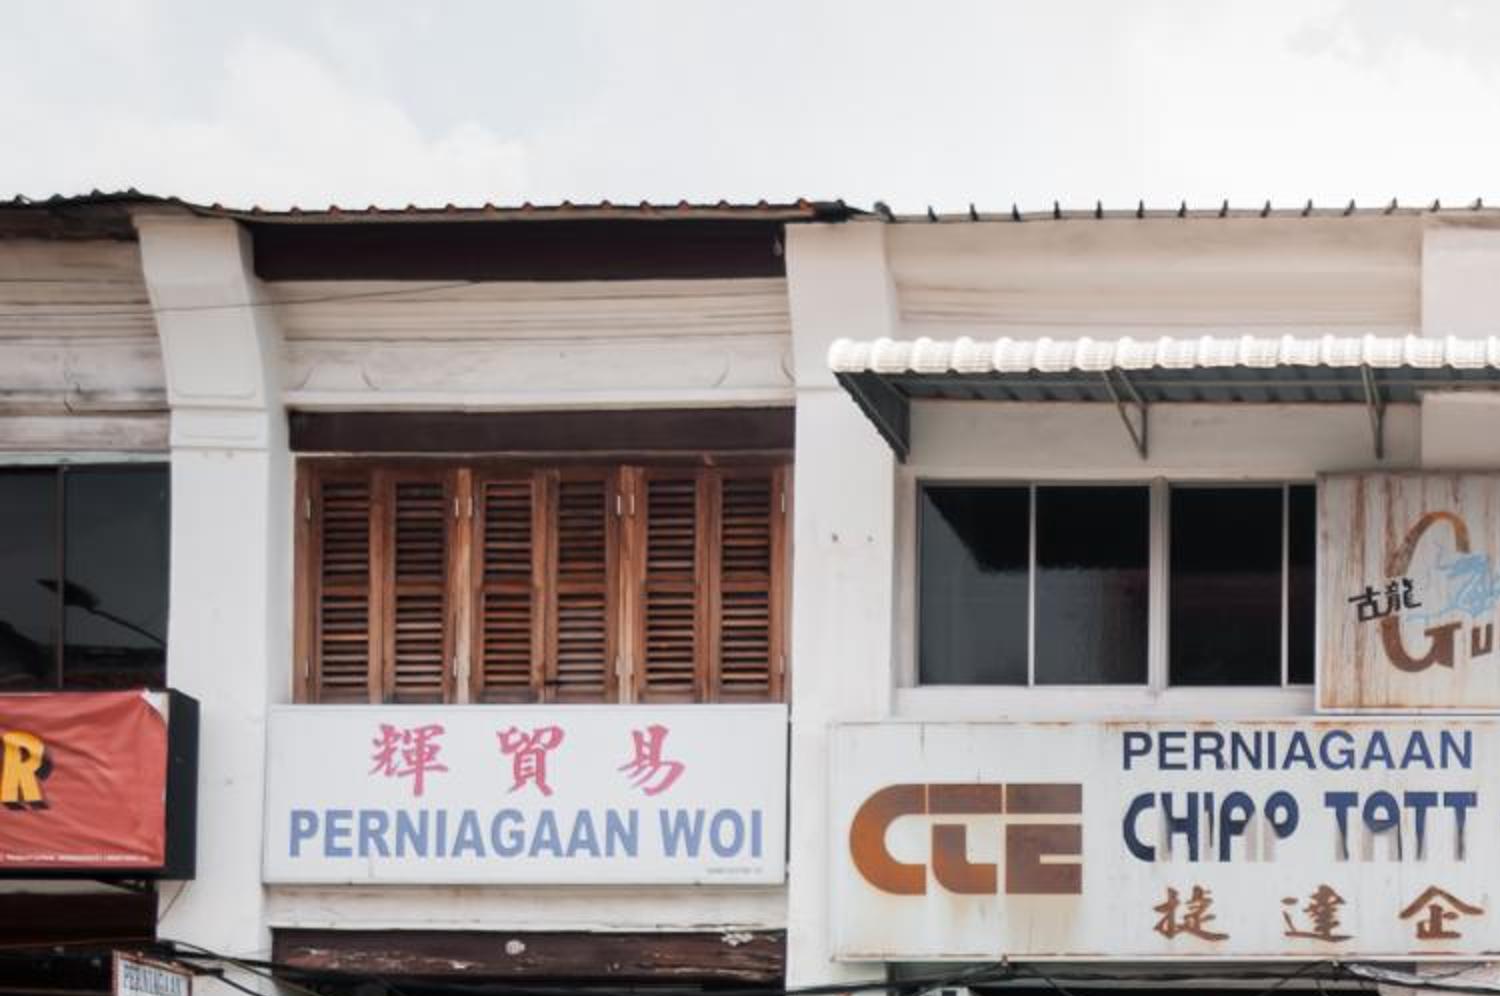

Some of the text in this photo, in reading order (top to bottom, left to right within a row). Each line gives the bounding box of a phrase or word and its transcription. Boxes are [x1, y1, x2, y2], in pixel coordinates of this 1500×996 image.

[1122, 730, 1473, 770] PERNIAGAAN
[289, 808, 763, 858] PERNIAGAAN WOI
[1325, 791, 1478, 863] TATT
